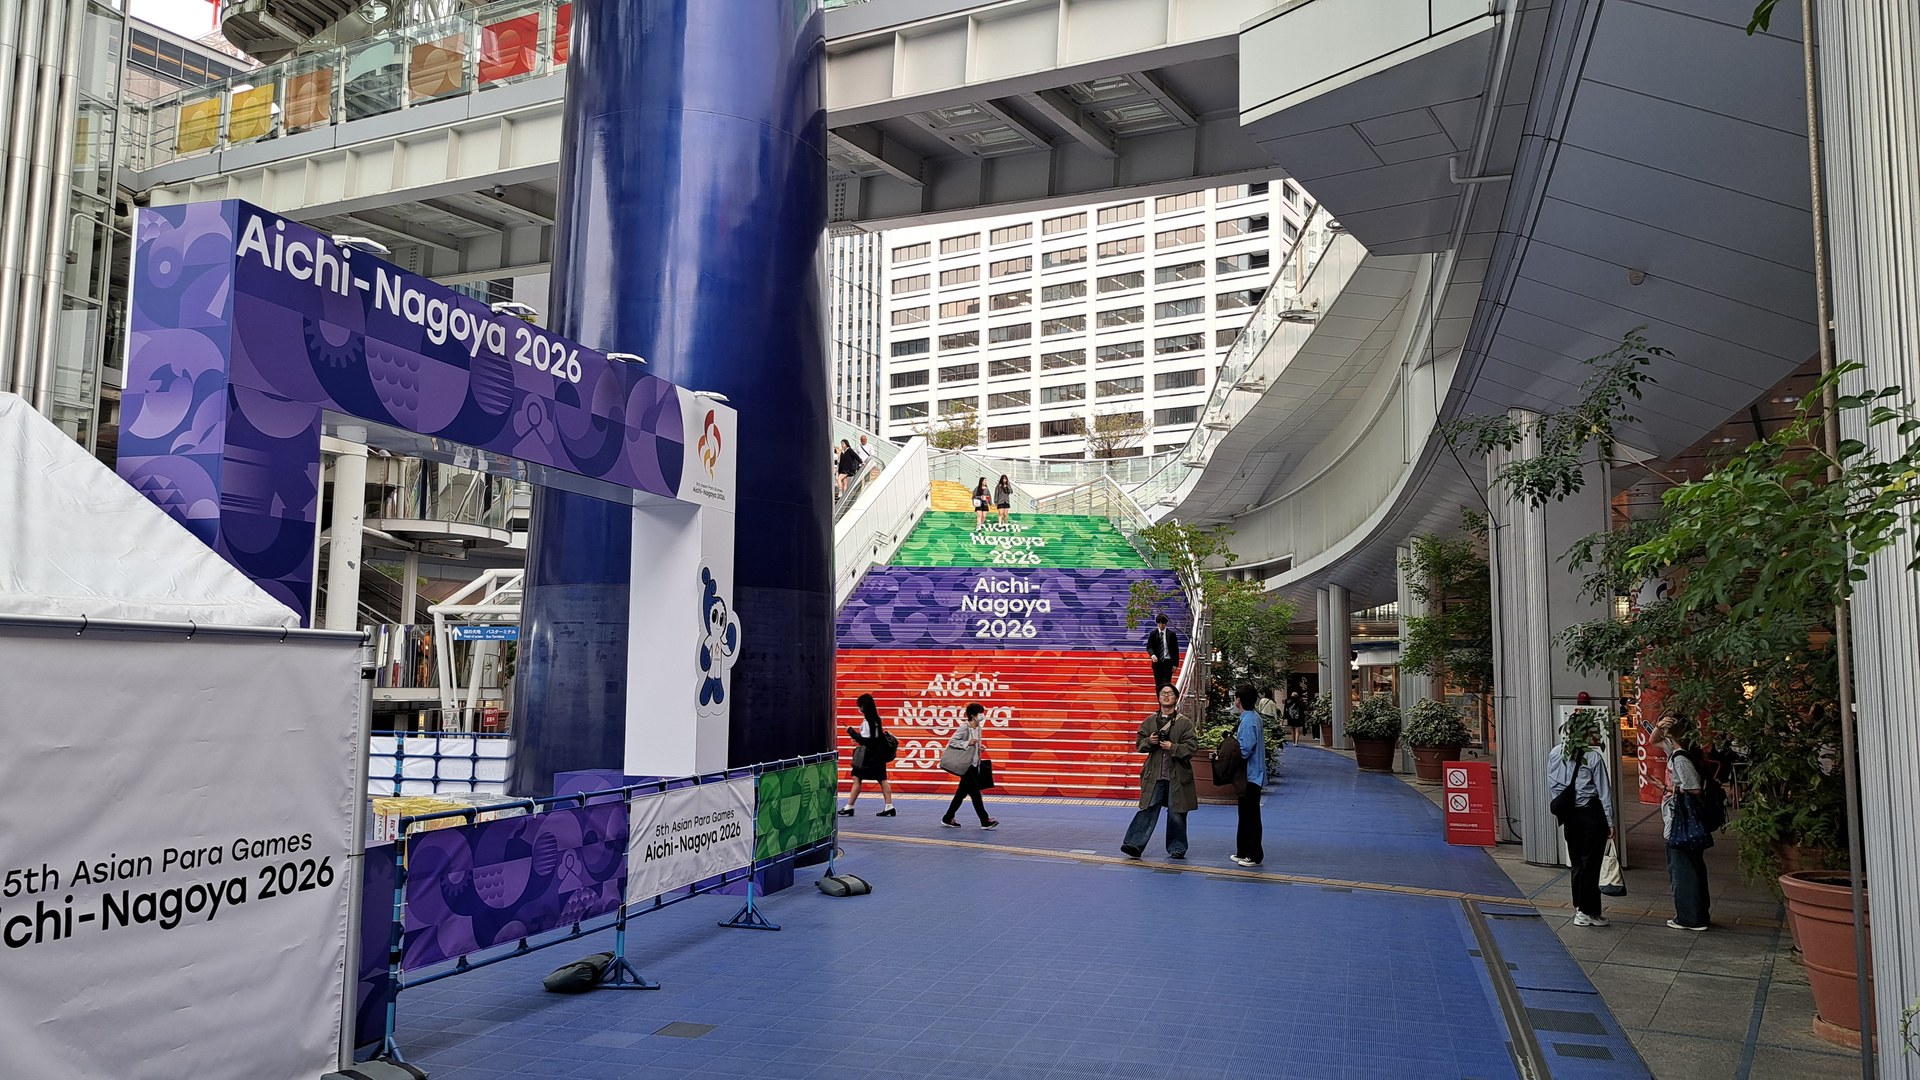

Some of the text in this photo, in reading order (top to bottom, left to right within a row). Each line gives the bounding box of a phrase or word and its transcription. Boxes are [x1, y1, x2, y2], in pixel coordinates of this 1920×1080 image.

[236, 214, 582, 384] Aichi-Nagoya 2026
[692, 486, 726, 501] Aichi-Nagoya 2026
[969, 532, 1045, 550] Nagoya
[990, 550, 1041, 565] 2026
[973, 576, 1040, 594] Aichi-
[961, 595, 1051, 618] Nagoya
[975, 619, 1038, 638] 2026
[920, 671, 1010, 697] Aichi-
[1636, 732, 1648, 789] 2026
[655, 809, 735, 837] 5th Asian Para Games
[644, 821, 741, 863] Aichi-Nagoya 2026
[3, 833, 313, 898] 5th Asian Para Games
[0, 855, 335, 949] chi-Nagoya 2026
